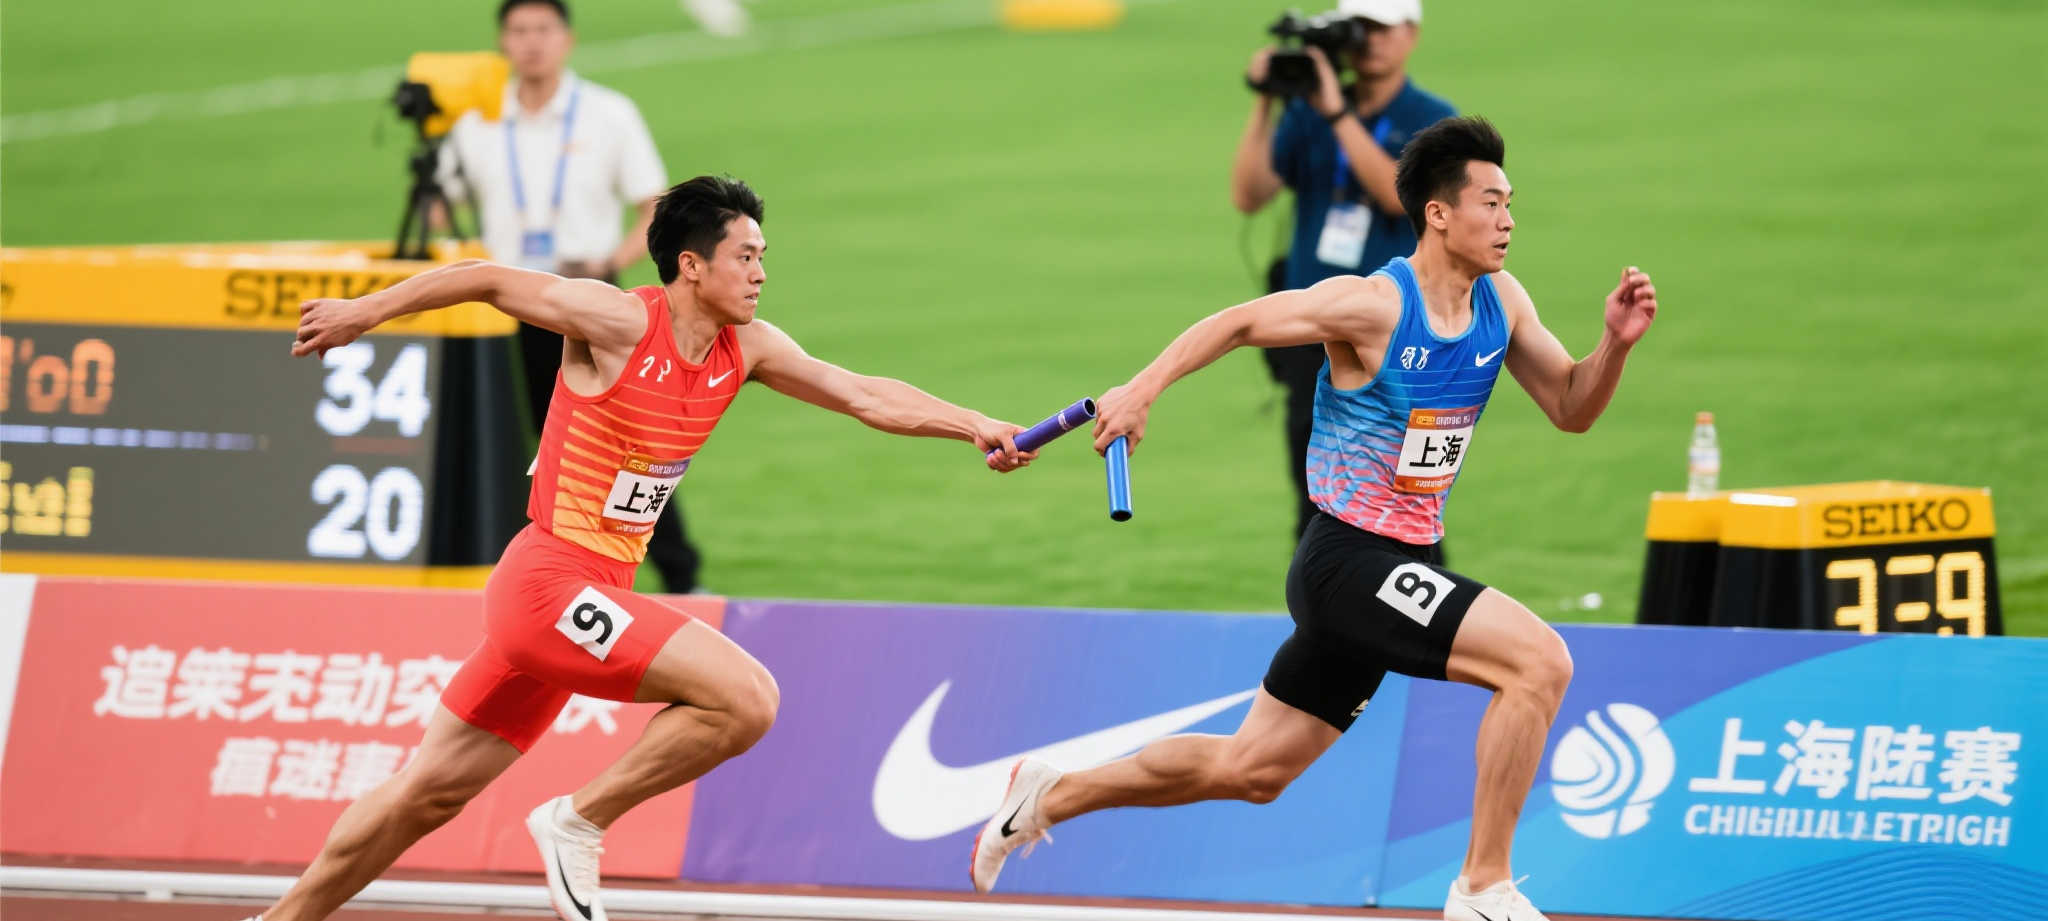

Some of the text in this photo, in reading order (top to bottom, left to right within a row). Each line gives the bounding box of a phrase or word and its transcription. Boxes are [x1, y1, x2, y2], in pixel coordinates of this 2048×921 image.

[315, 341, 431, 438] 34
[1409, 434, 1464, 467] 上海
[307, 464, 425, 560] 20
[1823, 498, 1971, 539] SEIKO
